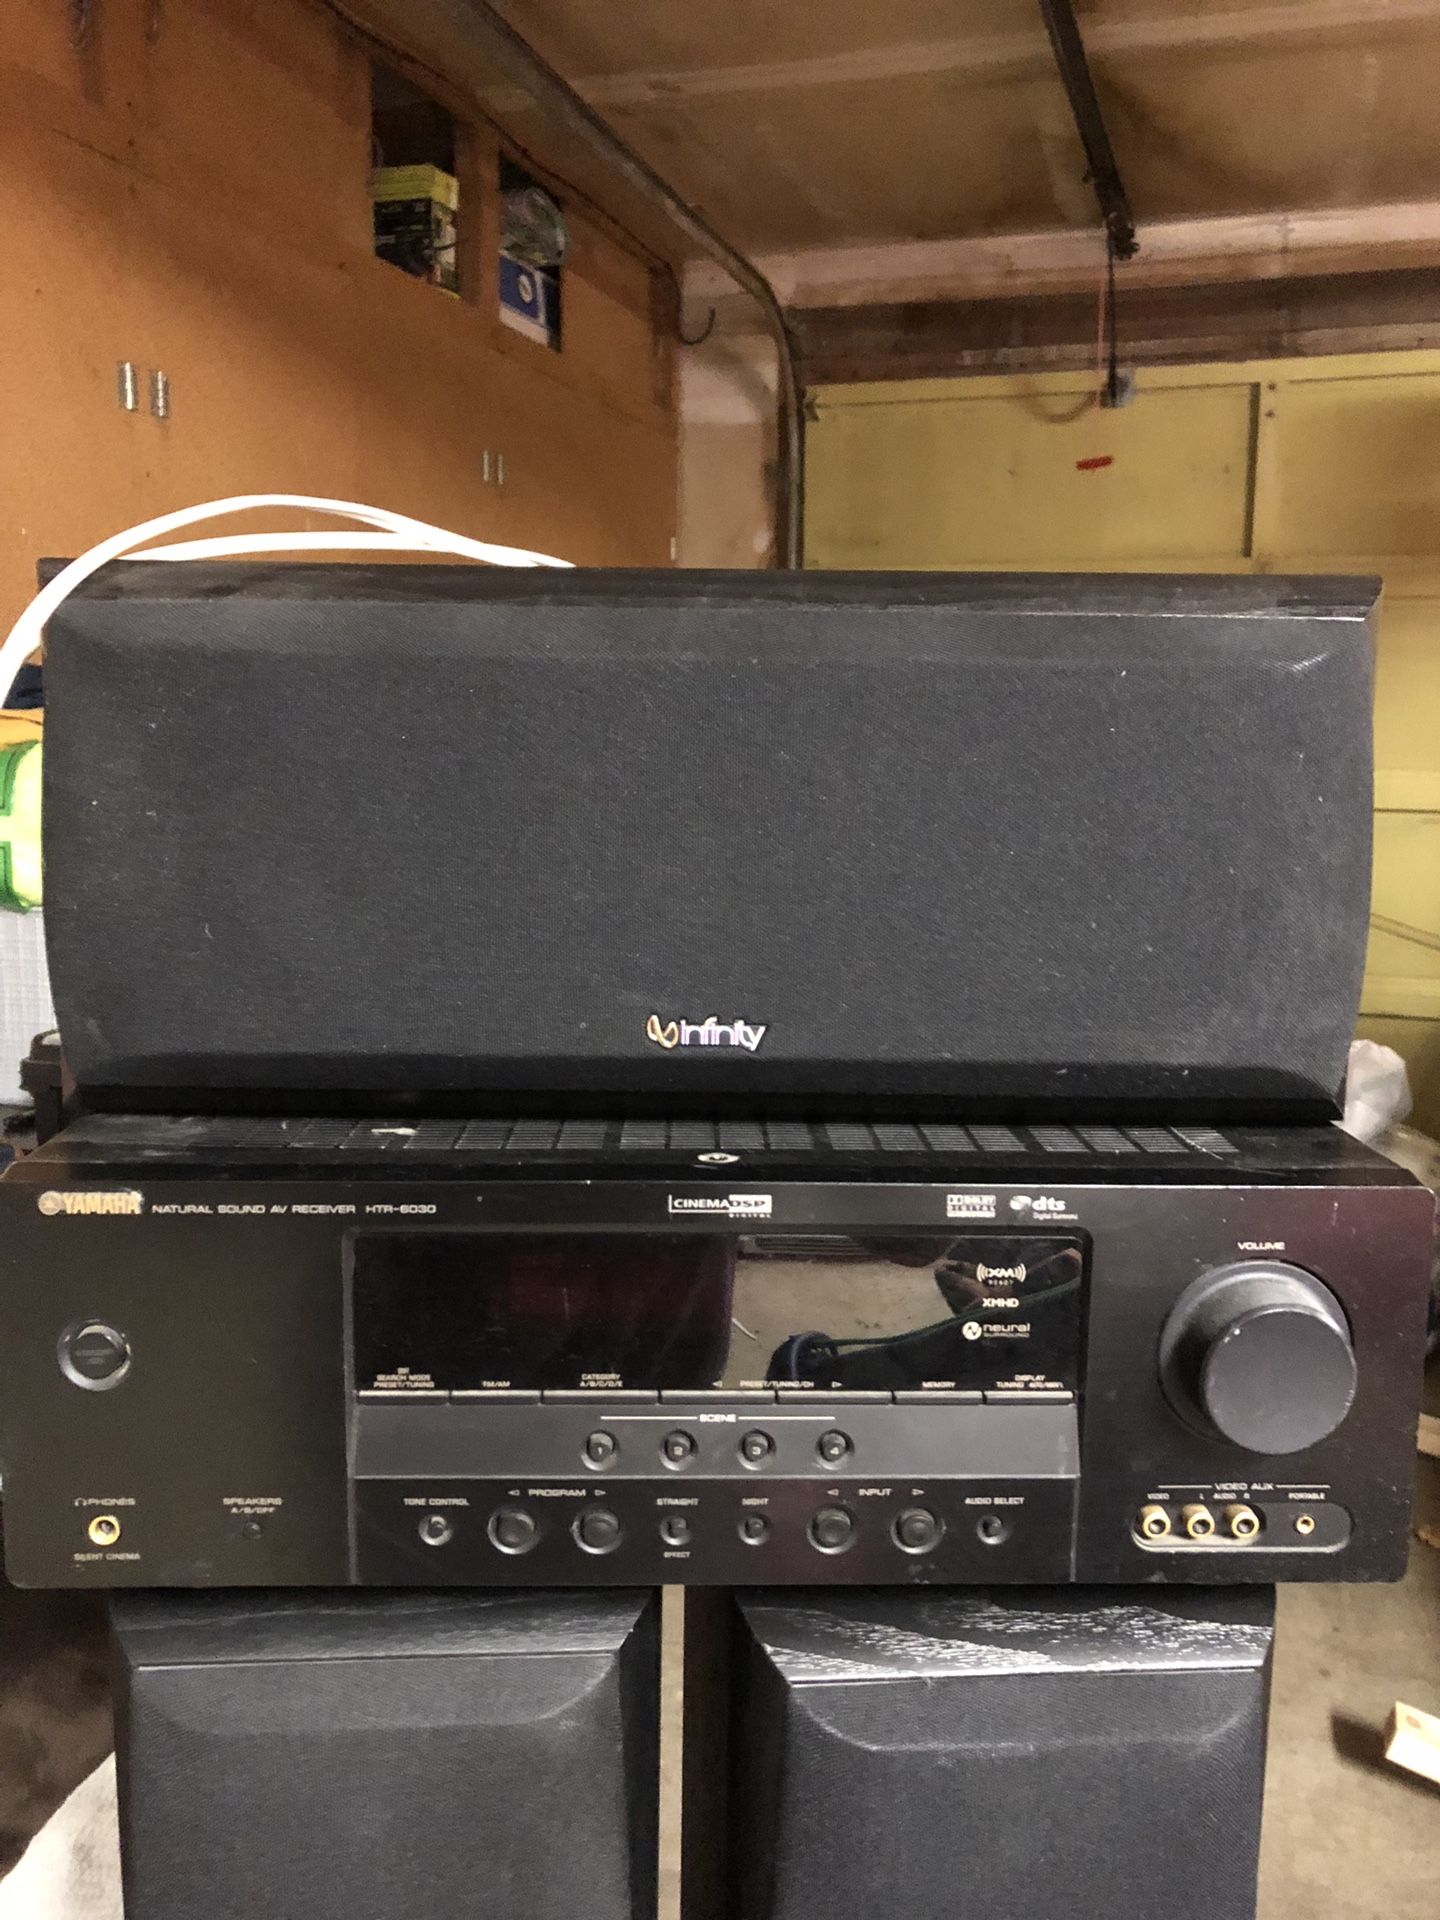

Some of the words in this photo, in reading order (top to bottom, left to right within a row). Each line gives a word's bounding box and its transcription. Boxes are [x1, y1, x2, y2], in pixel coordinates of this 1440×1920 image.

[680, 1016, 767, 1051] Infinity
[62, 1191, 144, 1215] YAMAHA
[1031, 1196, 1066, 1211] dts
[152, 1204, 213, 1214] NATURAL
[217, 1204, 266, 1214] SOUND
[270, 1204, 287, 1214] AV
[291, 1204, 356, 1214] RECEIVER
[366, 1204, 437, 1214] HTR-6030
[1237, 1241, 1286, 1250] VOLUME
[982, 1297, 1020, 1308] XMHD
[983, 1323, 1031, 1332] neural
[699, 1413, 737, 1423] SCENE
[528, 1489, 587, 1497] PROGRAM
[858, 1488, 892, 1497] INPUT
[403, 1498, 426, 1506] TONE
[428, 1498, 470, 1506] CONTROL
[964, 1497, 993, 1505] AUDIO
[993, 1497, 1025, 1505] SELECT
